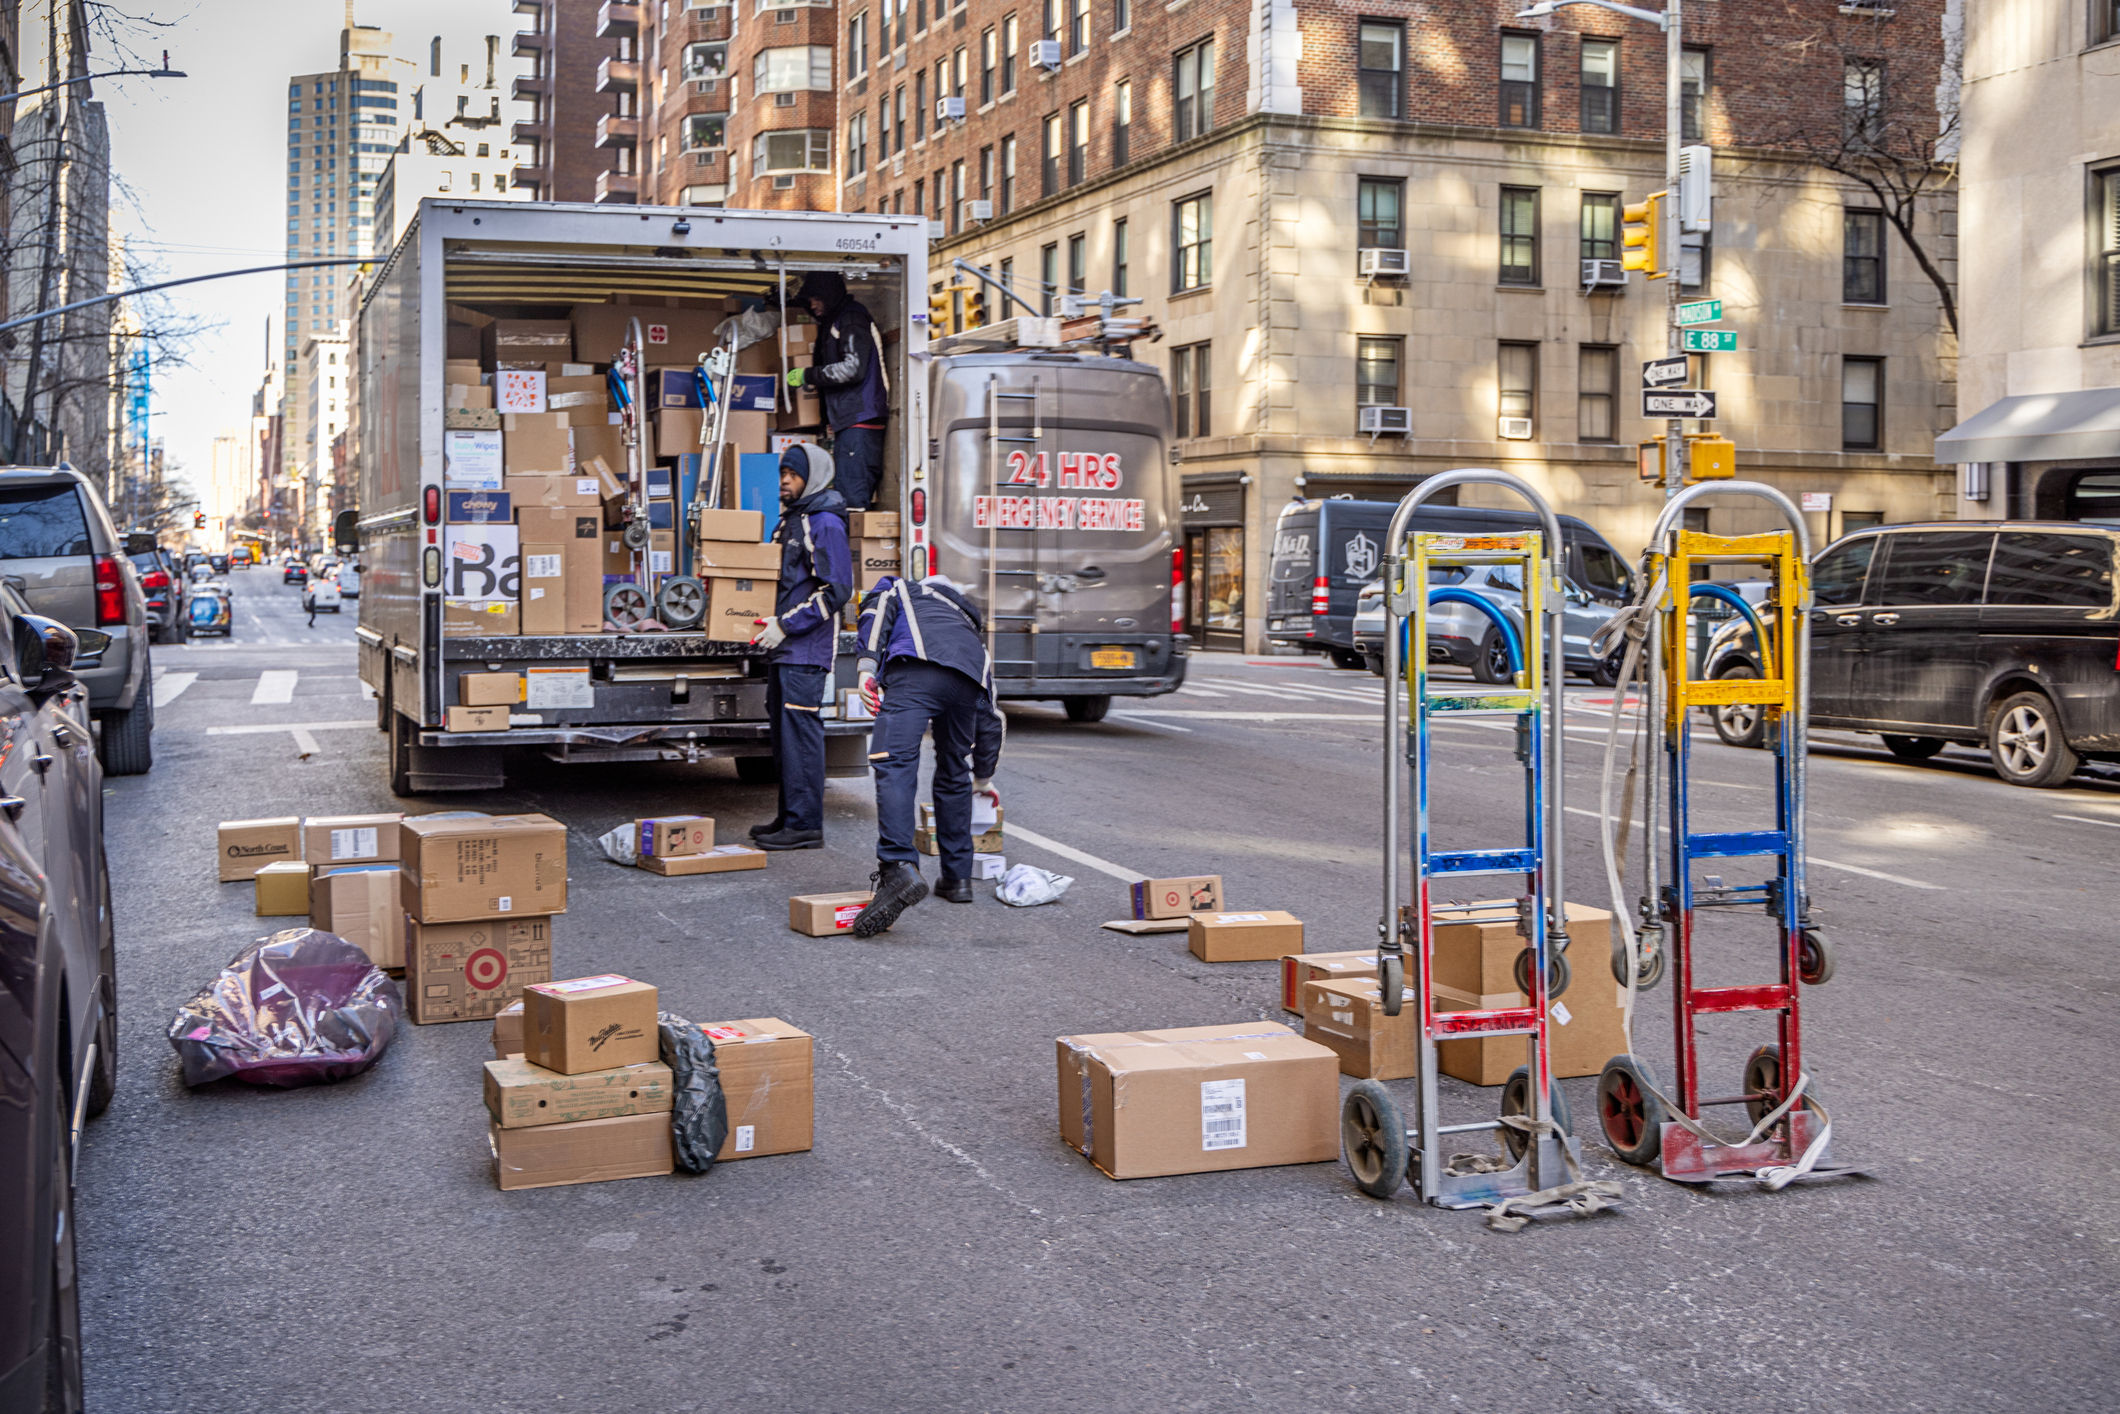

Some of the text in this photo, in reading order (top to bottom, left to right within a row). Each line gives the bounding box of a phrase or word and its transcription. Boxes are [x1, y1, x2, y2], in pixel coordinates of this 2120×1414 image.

[836, 238, 876, 250] 460544
[1681, 304, 1712, 323] MADISON
[1687, 332, 1732, 349] E 88 ST
[1650, 366, 1682, 380] ONE WAY
[1653, 398, 1706, 410] ONE WAY
[1006, 450, 1122, 490] 24 HRS
[462, 500, 498, 511] chewy
[973, 495, 1078, 530] EMERGENCY
[1078, 497, 1146, 532] SERVICE
[865, 558, 900, 568] COSTC
[240, 843, 288, 854] North Coast
